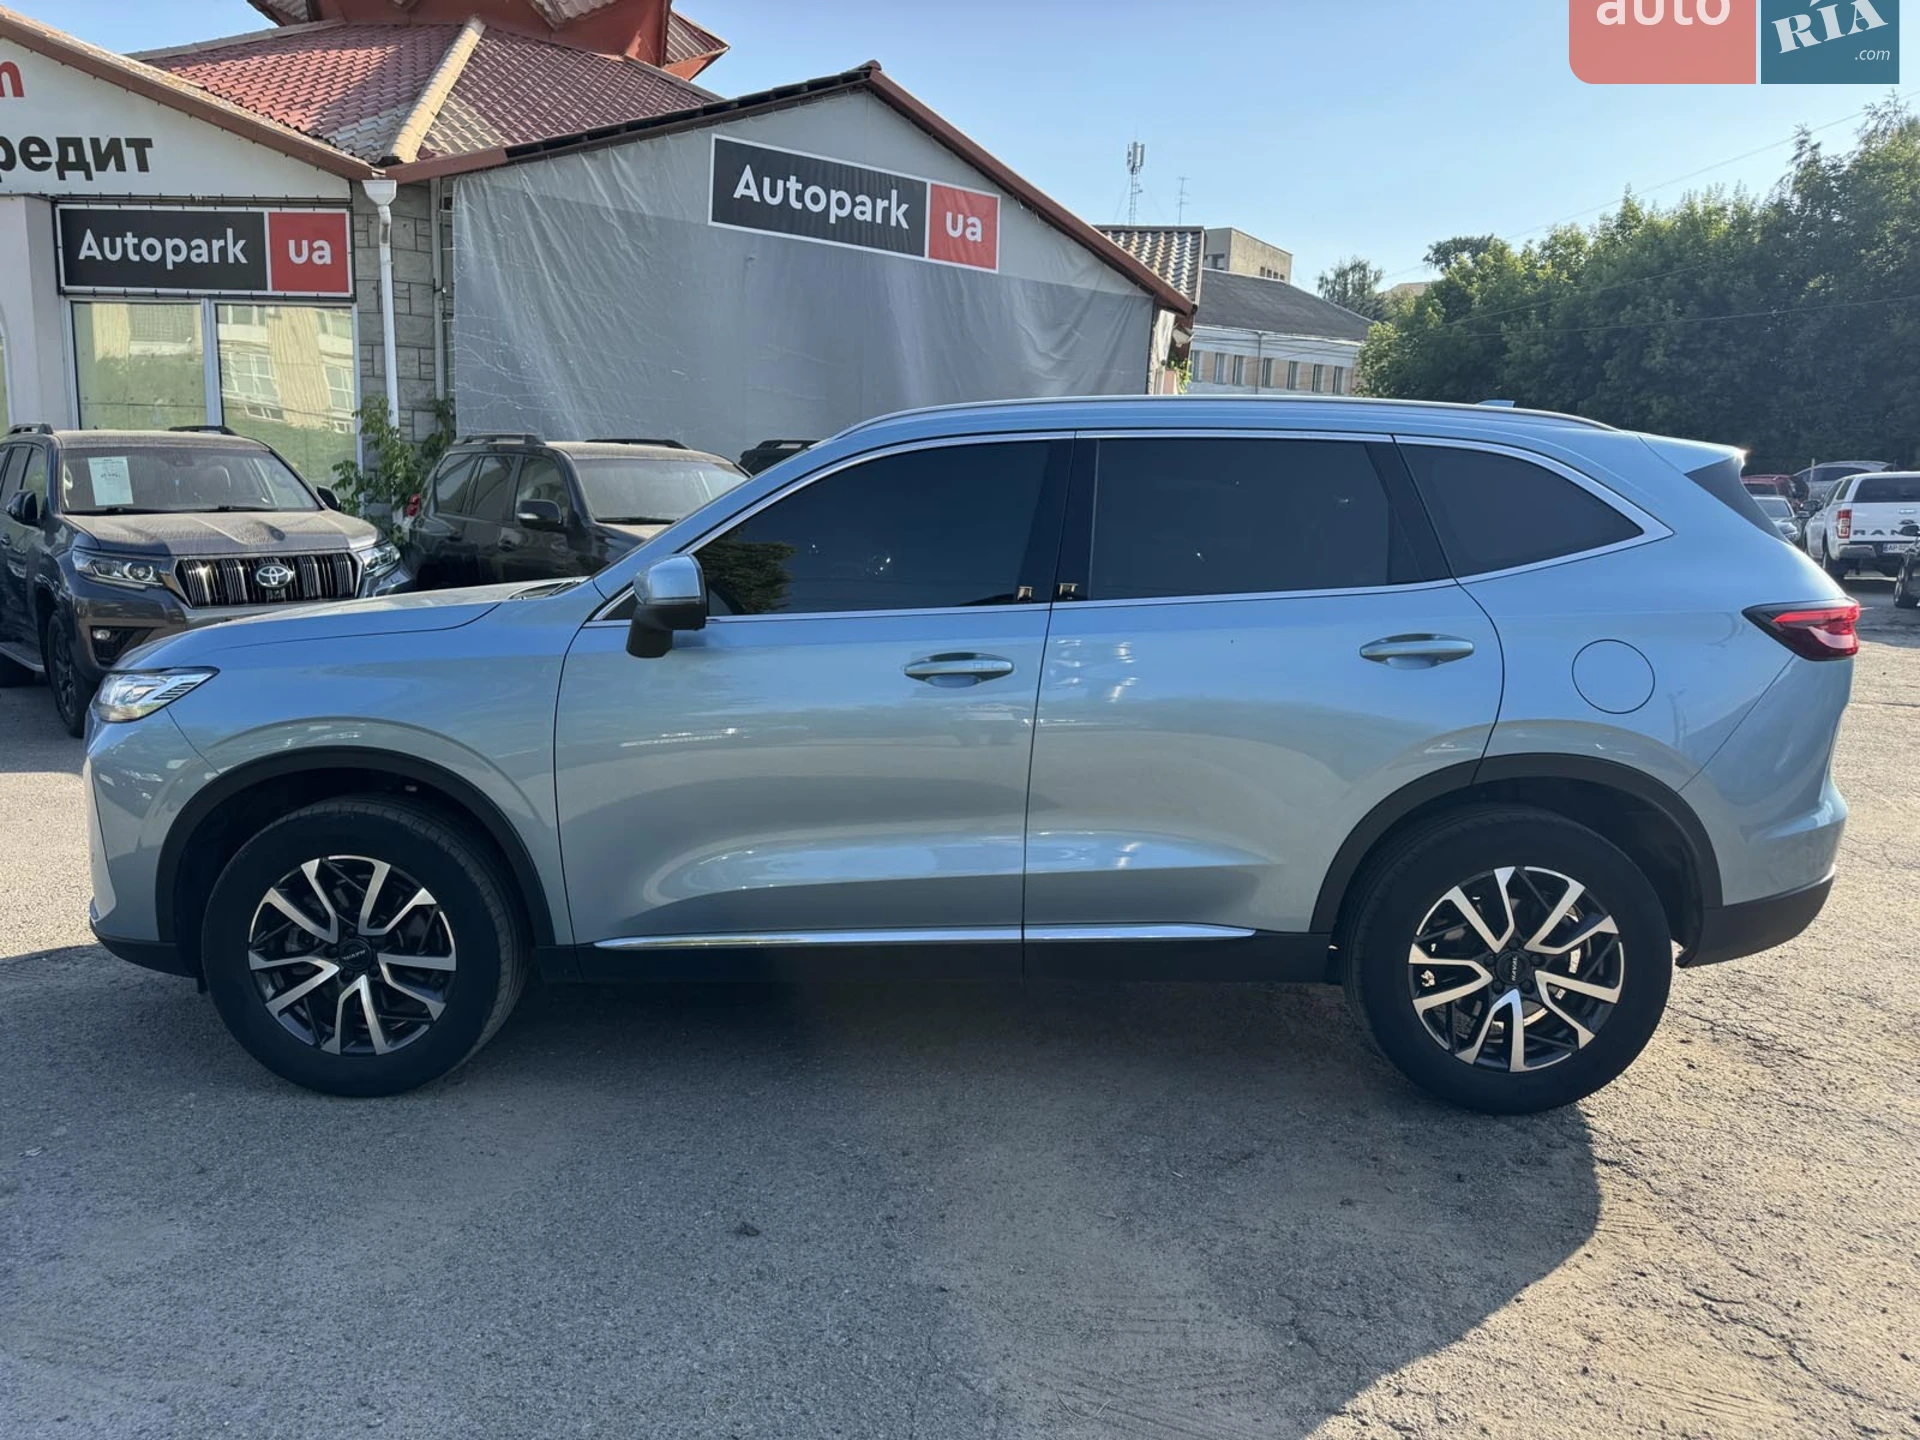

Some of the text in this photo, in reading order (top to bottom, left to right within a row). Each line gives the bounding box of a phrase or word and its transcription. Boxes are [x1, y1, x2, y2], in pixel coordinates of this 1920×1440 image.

[732, 163, 983, 243] Autopark ua
[78, 227, 332, 271] Autopark ua
